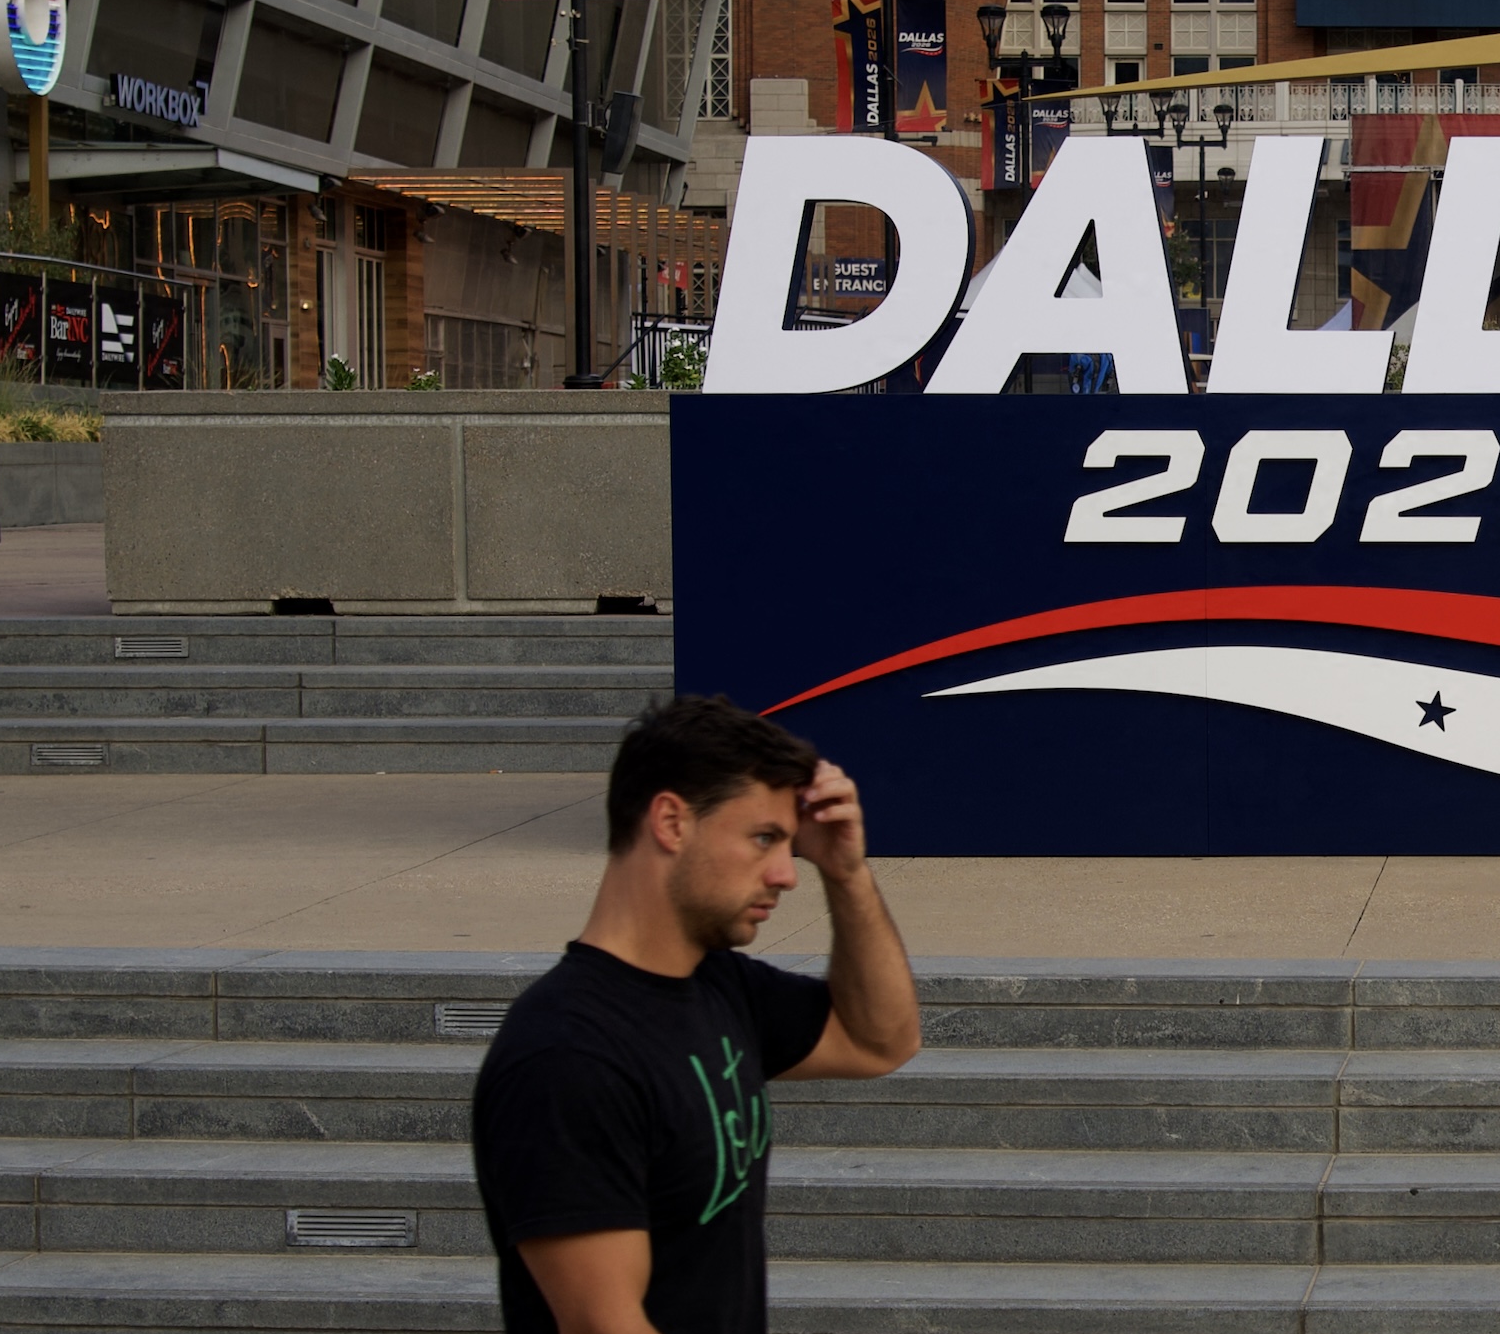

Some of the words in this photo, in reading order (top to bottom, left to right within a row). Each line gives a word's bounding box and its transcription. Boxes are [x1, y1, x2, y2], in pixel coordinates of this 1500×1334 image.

[868, 18, 877, 61] 2026
[898, 32, 944, 43] DALLAS
[117, 73, 201, 127] WORKBOX
[866, 64, 879, 127] DALLAS
[1033, 109, 1069, 118] DALLAS
[1005, 134, 1016, 182] DALLAS
[833, 263, 878, 276] GUEST
